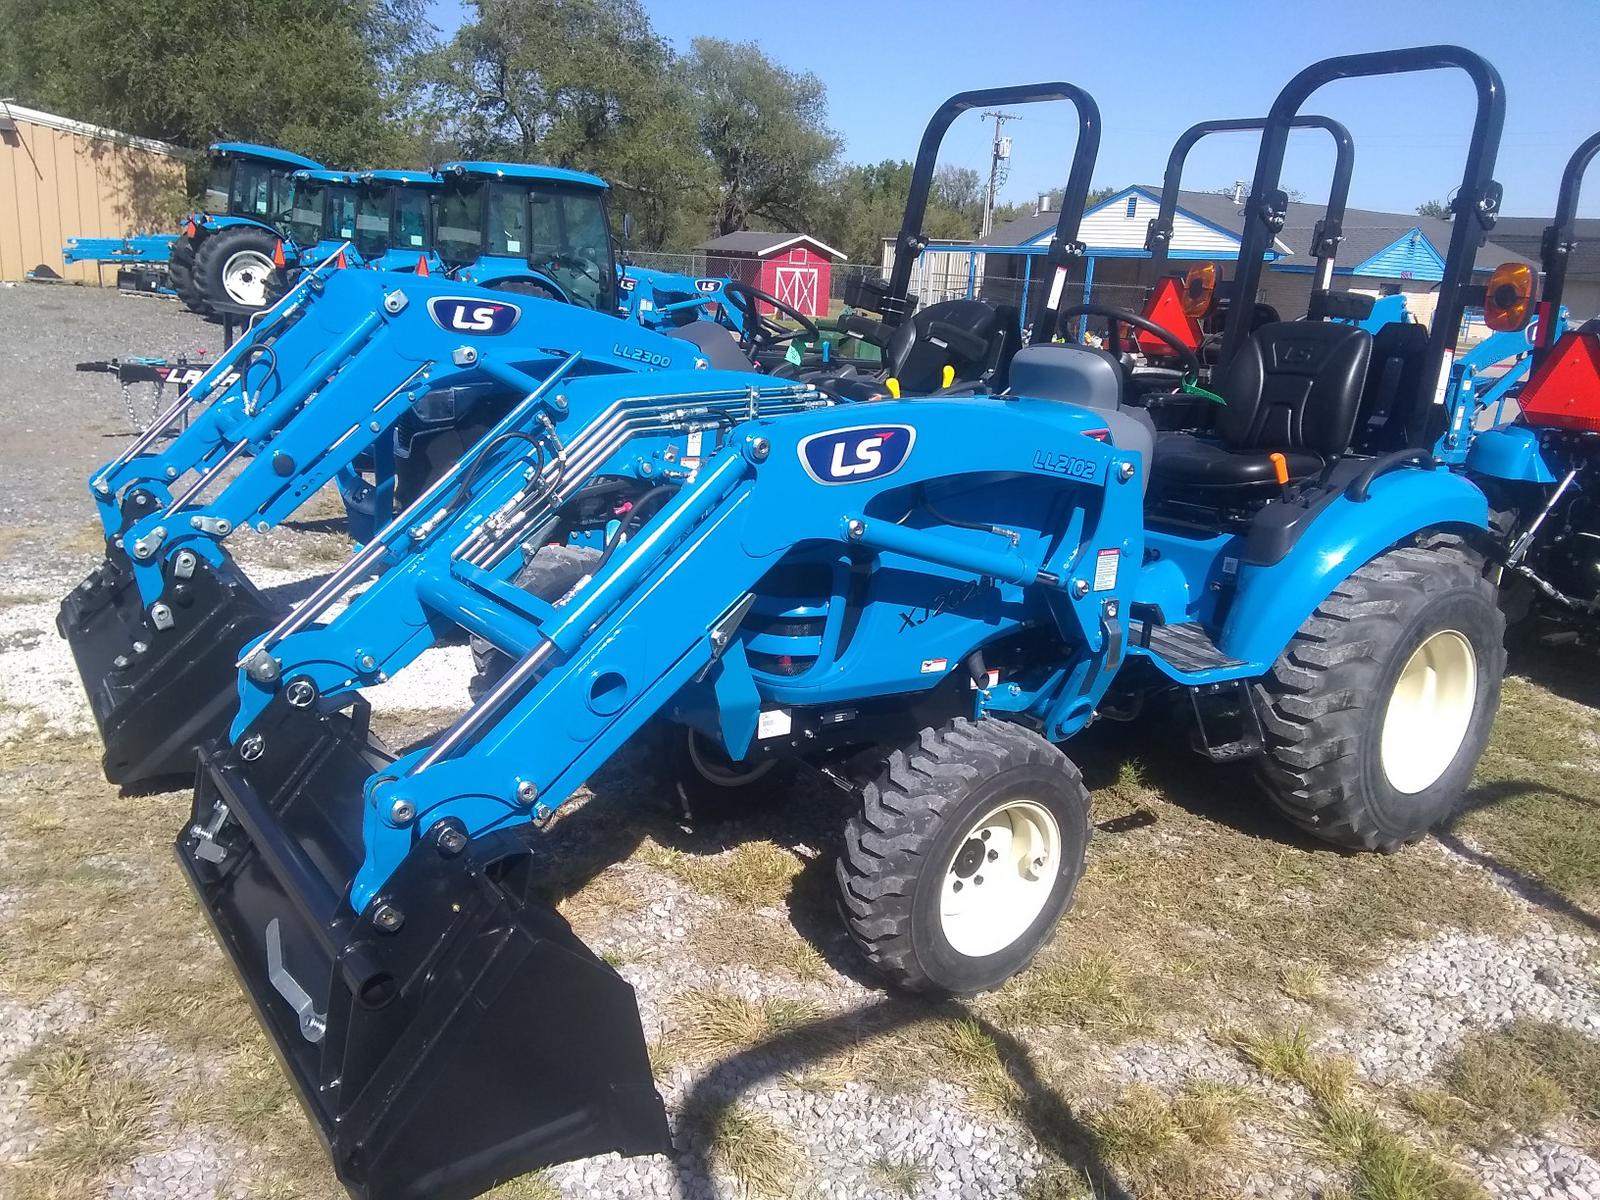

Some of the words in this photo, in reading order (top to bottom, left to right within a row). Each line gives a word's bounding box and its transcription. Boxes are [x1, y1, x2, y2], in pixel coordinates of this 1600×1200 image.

[701, 281, 717, 292] LS
[452, 305, 495, 331] LS
[612, 333, 671, 368] LL2300
[831, 437, 883, 478] LS
[1033, 449, 1096, 480] LL2102
